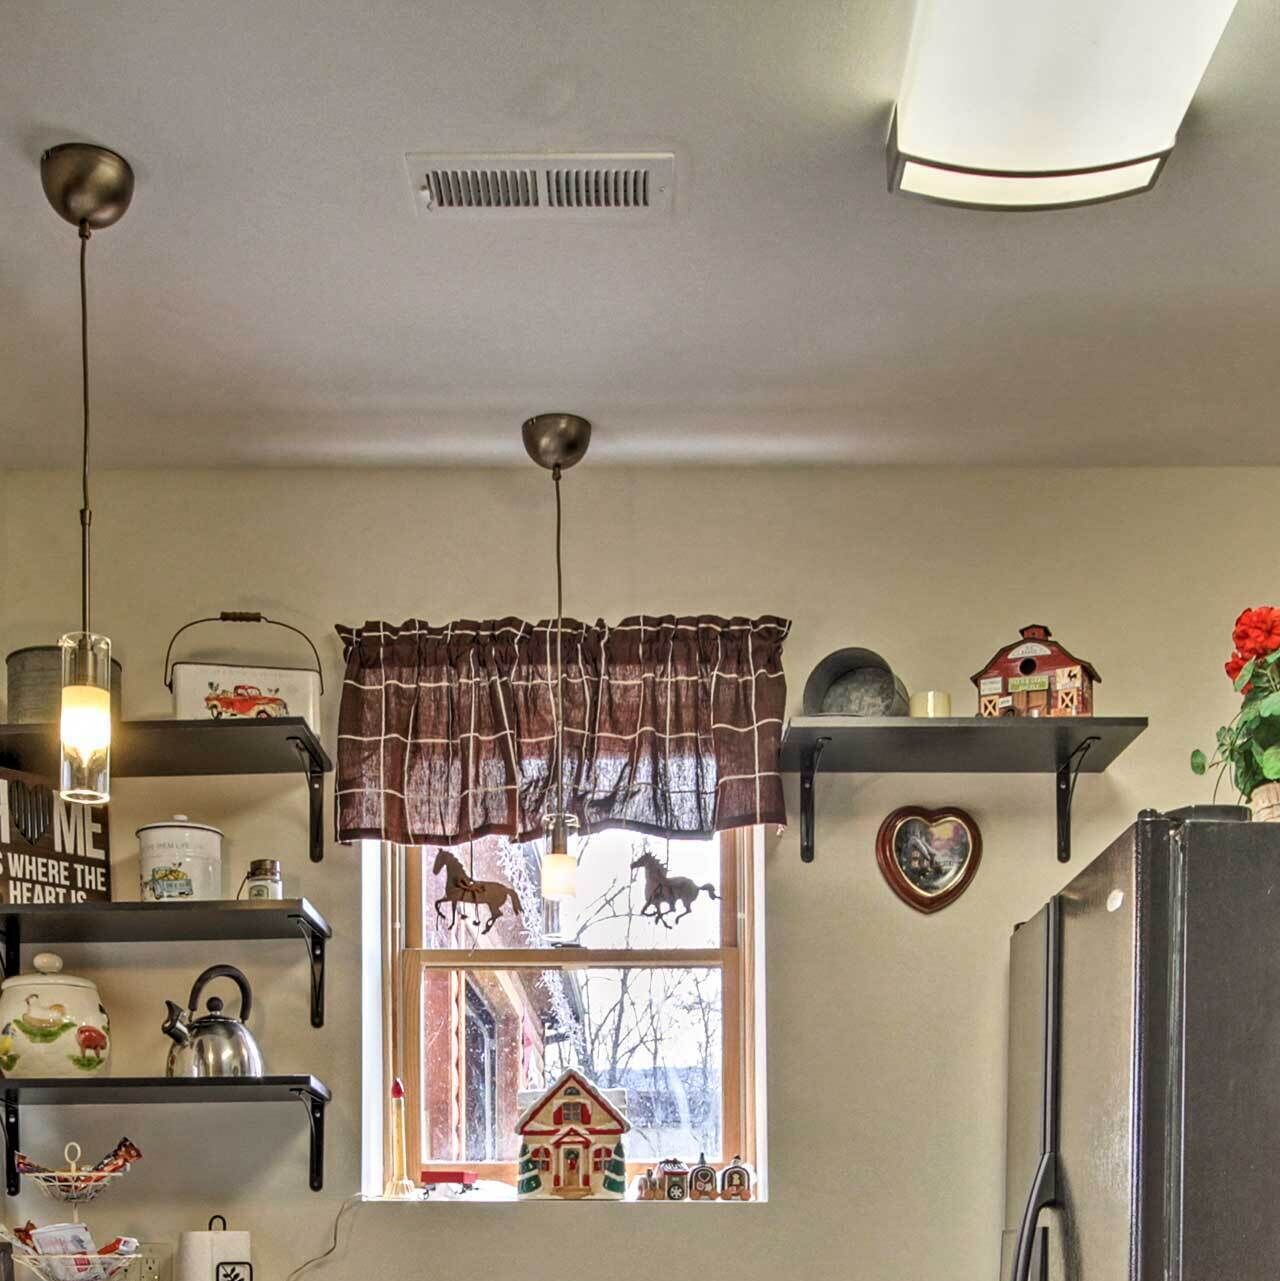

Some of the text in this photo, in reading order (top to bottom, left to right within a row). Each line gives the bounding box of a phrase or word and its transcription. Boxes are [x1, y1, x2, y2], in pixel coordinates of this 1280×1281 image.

[7, 852, 70, 886] WHERE
[73, 863, 107, 892] THE
[9, 880, 67, 905] HEART
